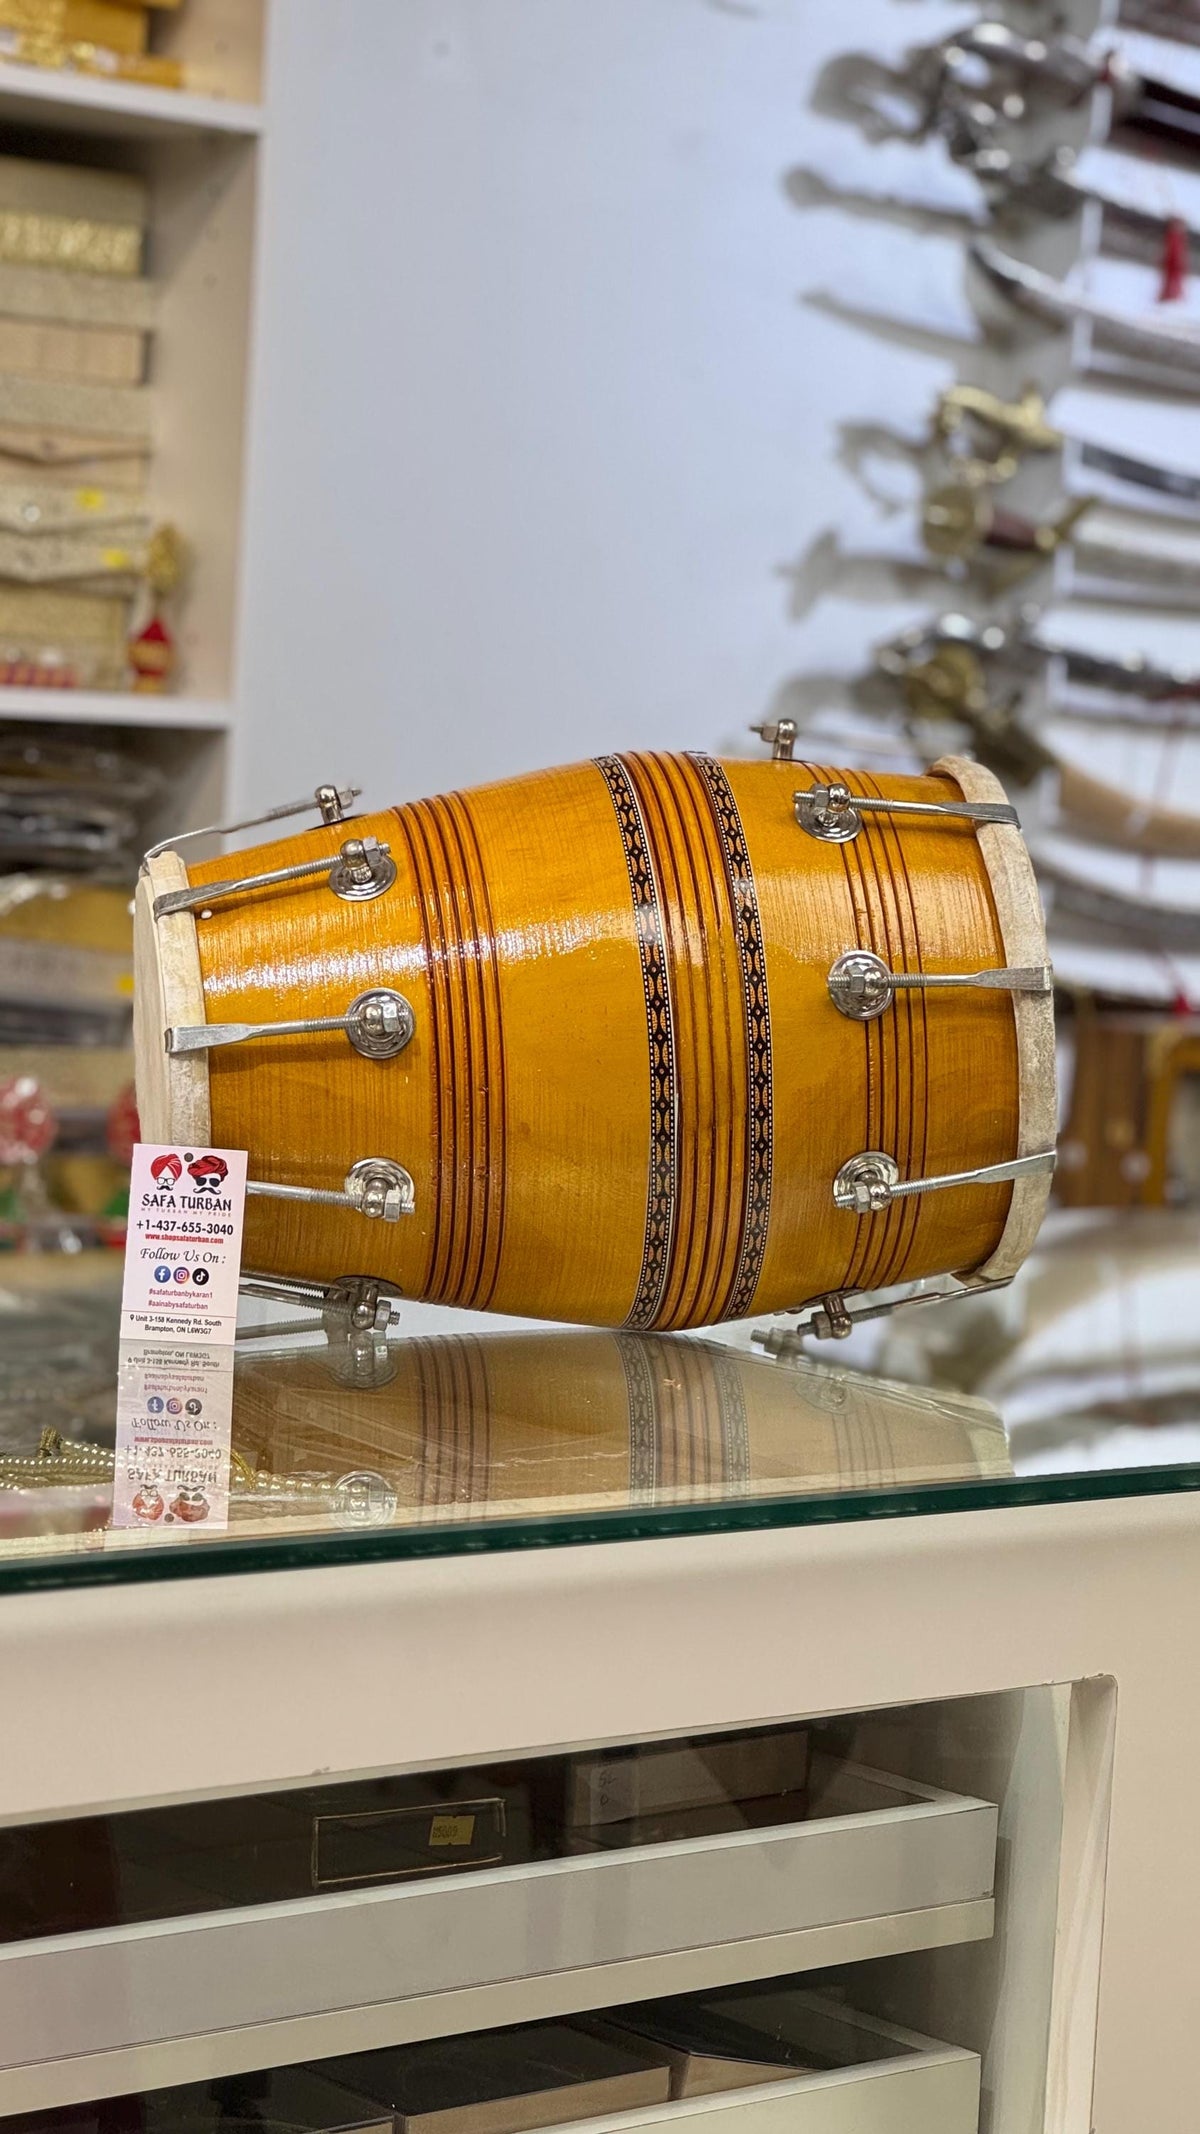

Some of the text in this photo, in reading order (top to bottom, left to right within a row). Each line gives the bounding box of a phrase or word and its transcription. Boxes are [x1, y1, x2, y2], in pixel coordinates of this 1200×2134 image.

[142, 1193, 232, 1211] SAFA TURBAN
[136, 1219, 234, 1235] +1-437-655-3040
[145, 1233, 224, 1244] www.shopsafaturban.com
[140, 1247, 180, 1260] Follow
[183, 1249, 200, 1262] Us
[148, 1288, 213, 1299] #safaturbanbykaran1
[148, 1300, 209, 1310] #aainabysafaturban
[149, 1315, 165, 1323] 3-158
[166, 1317, 191, 1326] Kennedy
[204, 1319, 222, 1327] South
[144, 1324, 175, 1333] Brampton,
[187, 1327, 212, 1335] L6W3G7
